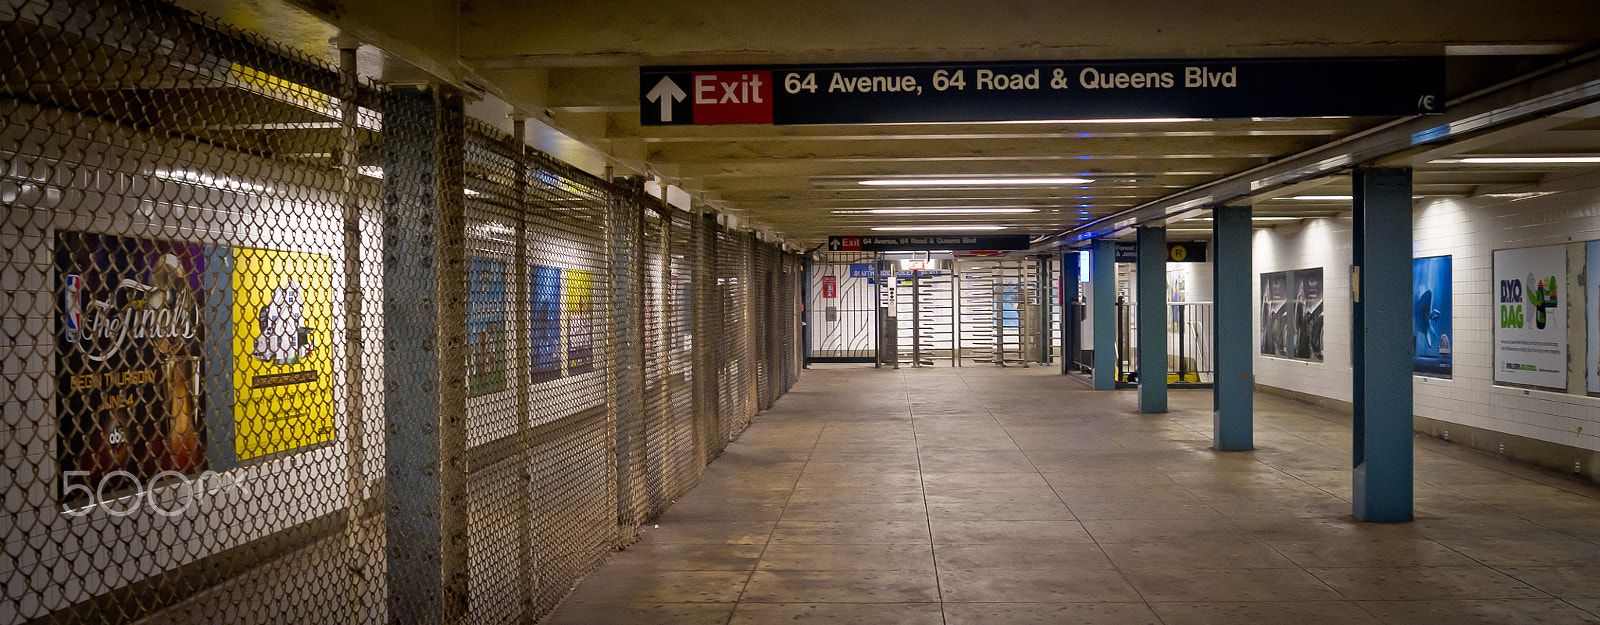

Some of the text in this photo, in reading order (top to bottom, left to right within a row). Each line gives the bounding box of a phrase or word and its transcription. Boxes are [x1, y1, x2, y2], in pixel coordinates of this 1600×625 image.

[695, 66, 1237, 105] Exit 64 Avenue, 64 Road & Queens Blvd
[842, 239, 860, 247] Exit
